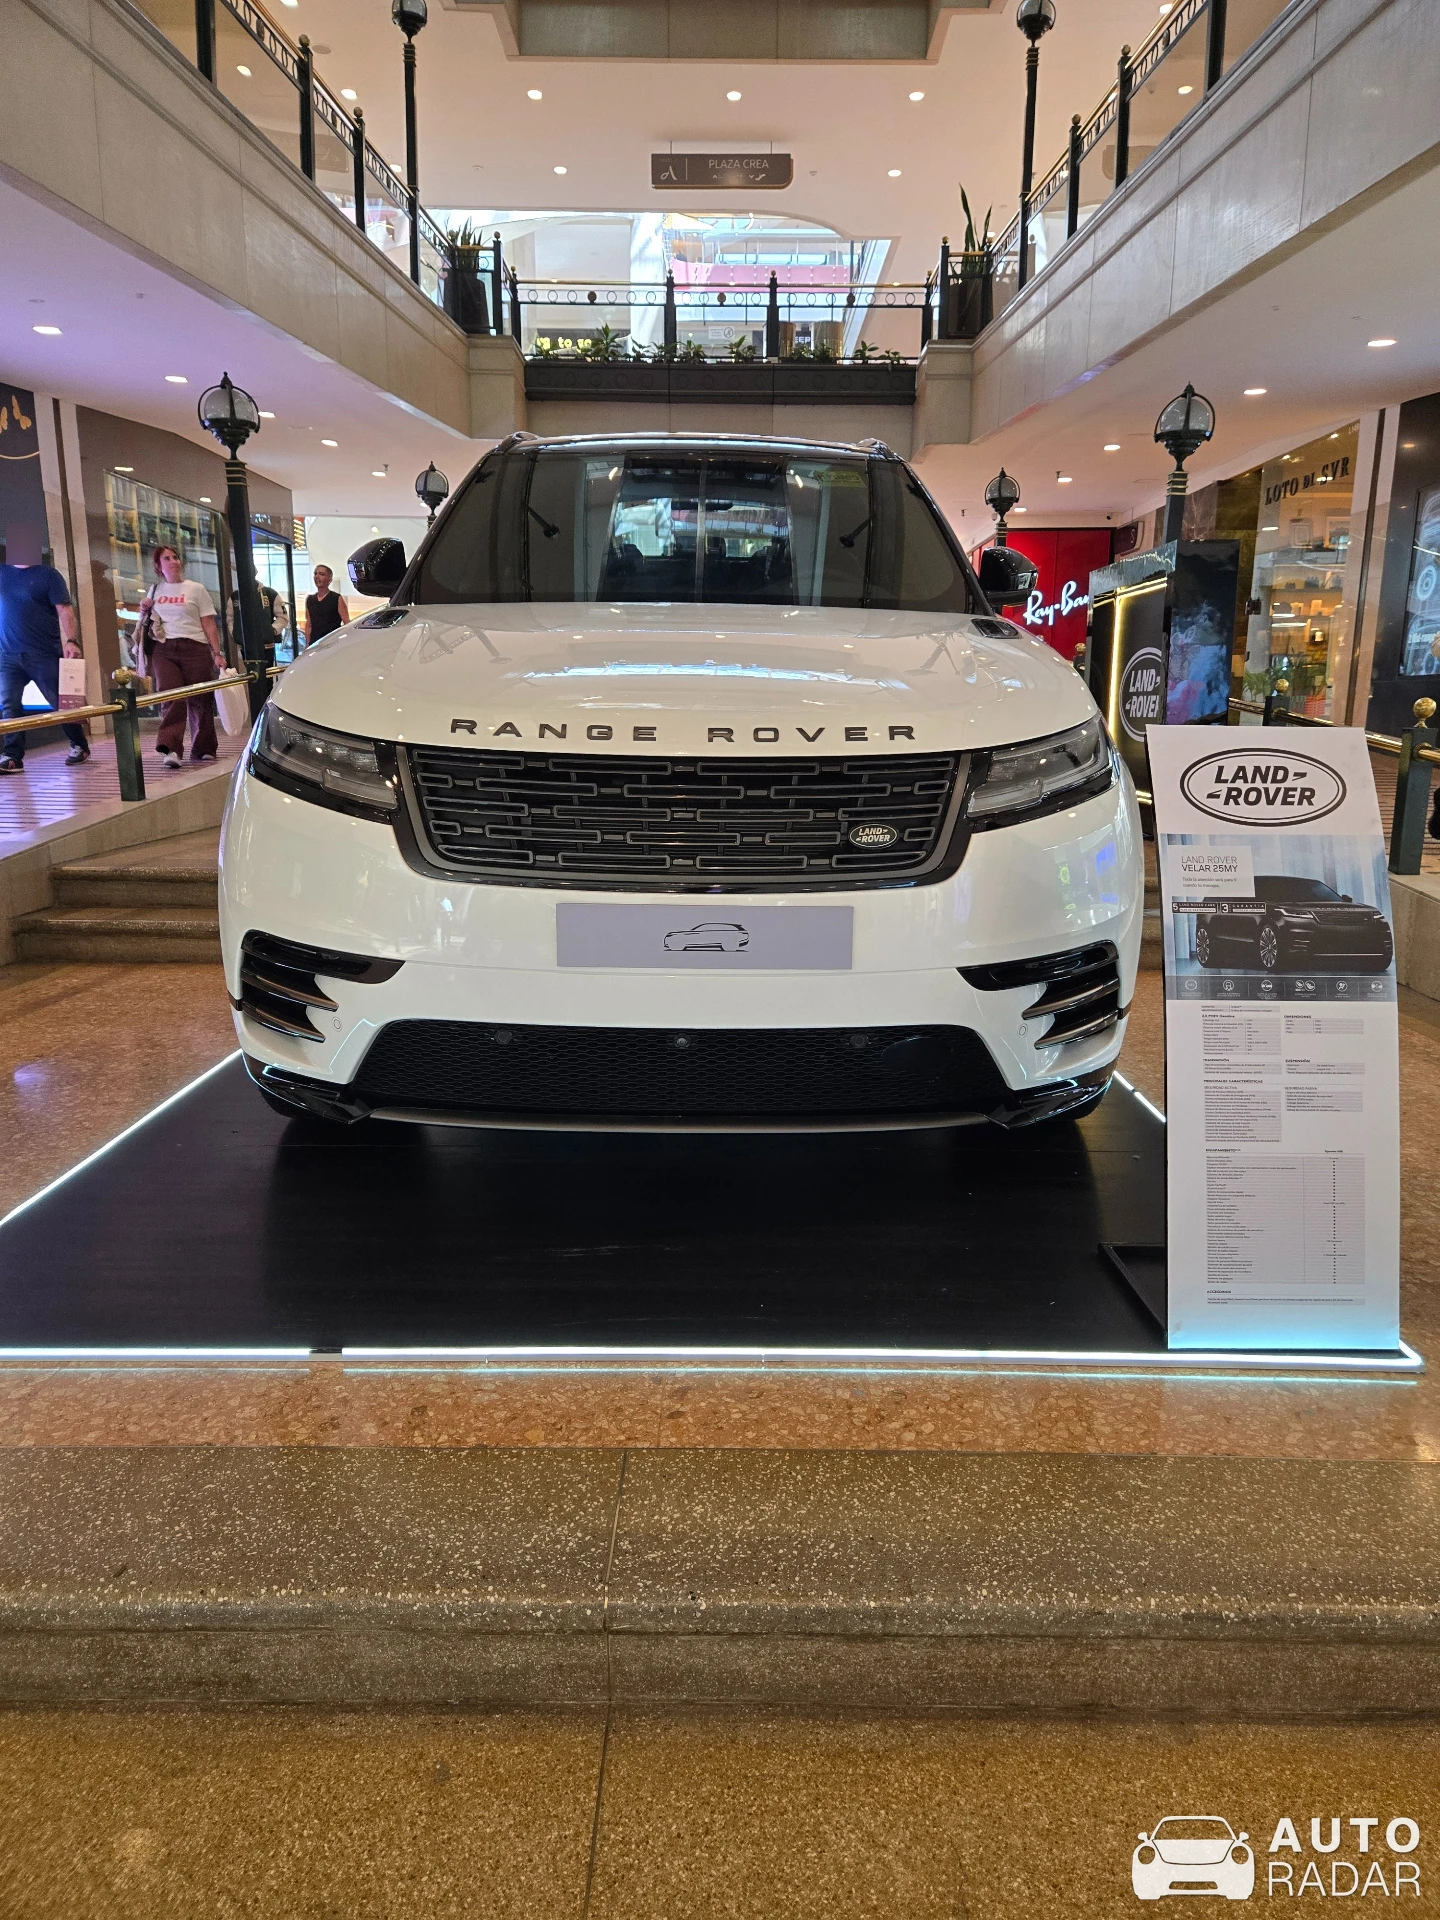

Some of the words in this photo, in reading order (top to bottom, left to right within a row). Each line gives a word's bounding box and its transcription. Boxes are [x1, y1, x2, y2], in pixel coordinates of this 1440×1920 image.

[708, 159, 741, 169] PLAZA
[742, 159, 770, 169] CREA
[558, 337, 572, 349] to
[1265, 477, 1299, 506] LOTO
[157, 593, 186, 605] Oui
[1129, 668, 1154, 693] LAND
[450, 718, 657, 742] RANGE
[707, 725, 916, 743] ROVER
[1214, 765, 1290, 784] LAND
[1223, 786, 1316, 806] ROVER
[1181, 855, 1205, 864] LAND
[1207, 855, 1238, 864] ROVER
[1181, 864, 1212, 872] VELAR
[1213, 864, 1238, 873] 25MY
[1172, 903, 1179, 911] 5
[1221, 903, 1229, 913] 3
